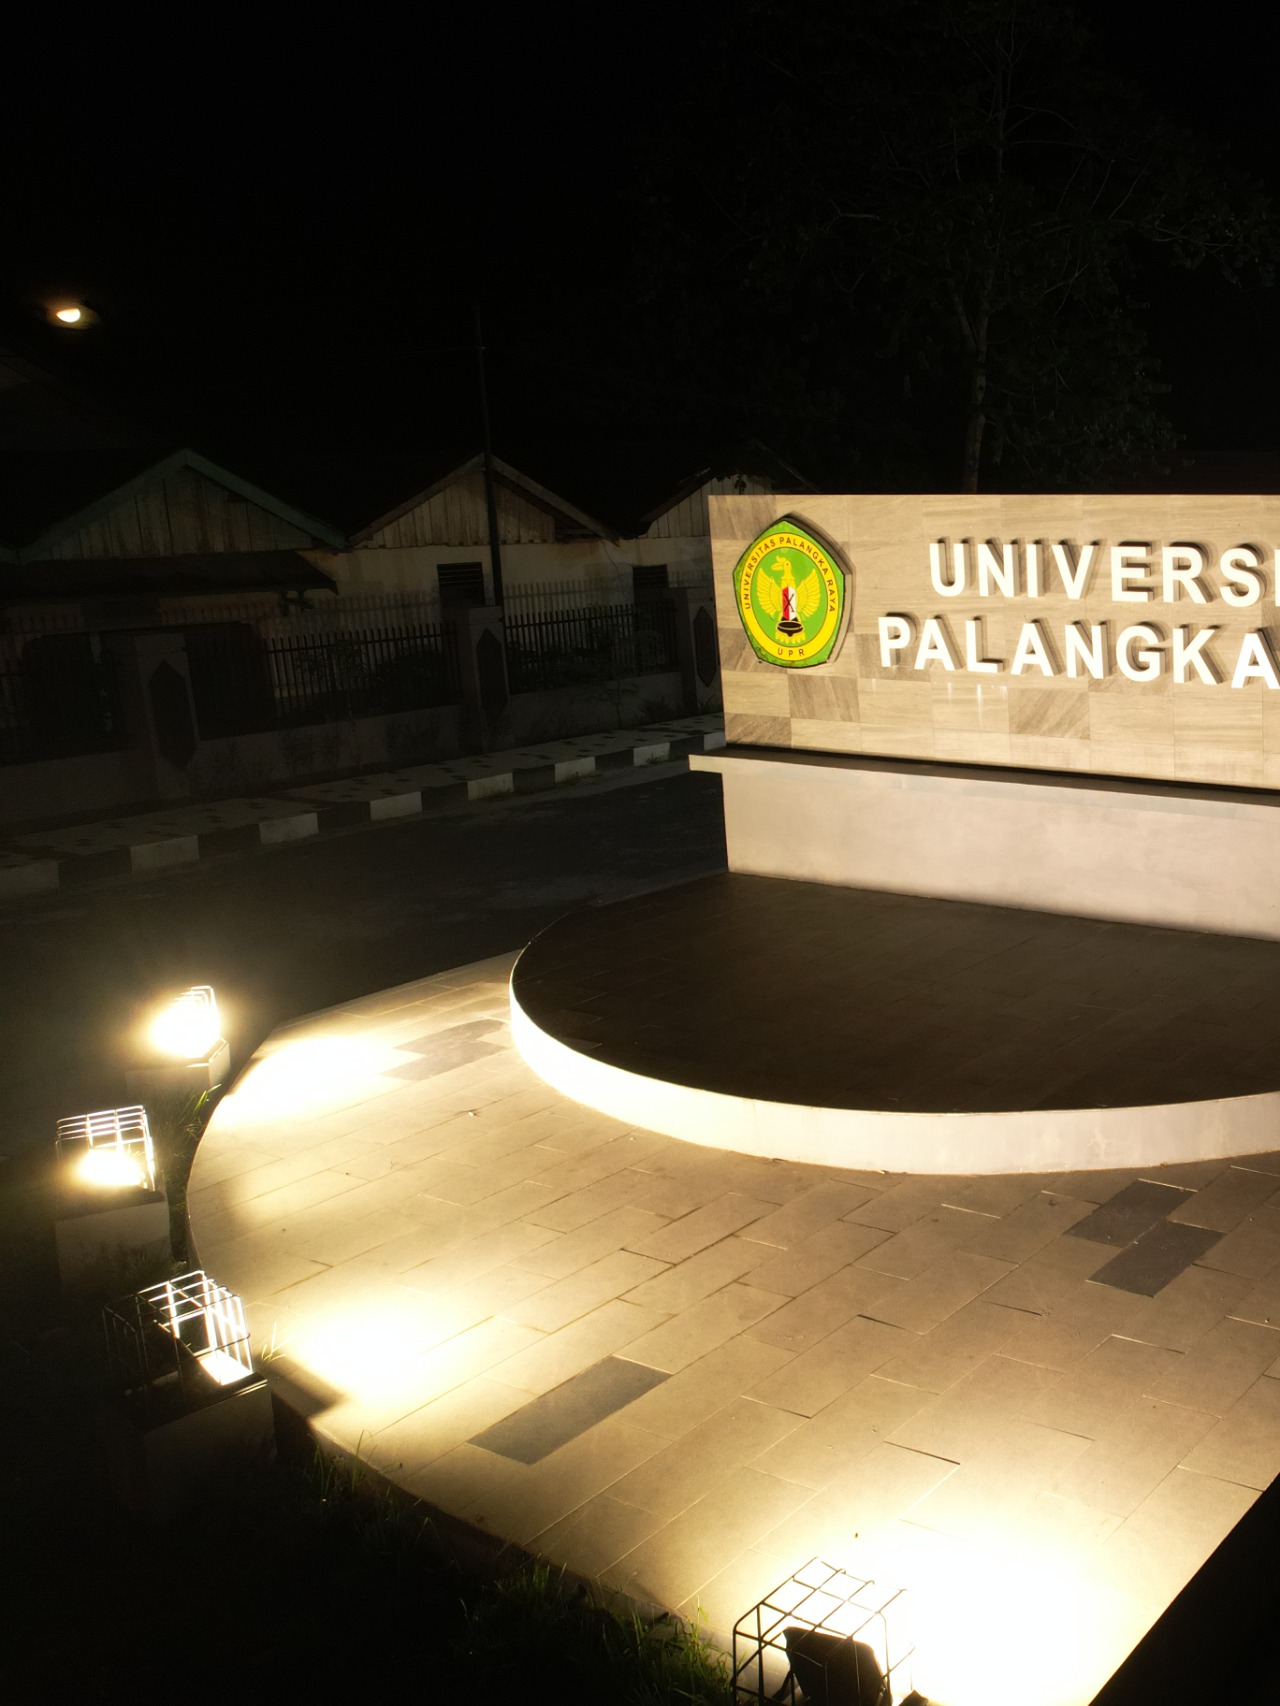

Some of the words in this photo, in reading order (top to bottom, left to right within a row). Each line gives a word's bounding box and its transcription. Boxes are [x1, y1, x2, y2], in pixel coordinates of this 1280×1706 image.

[744, 538, 776, 610] UNIVERSITAS
[779, 536, 829, 575] PALANGKA
[826, 579, 836, 612] RAYA
[777, 648, 805, 657] UPR
